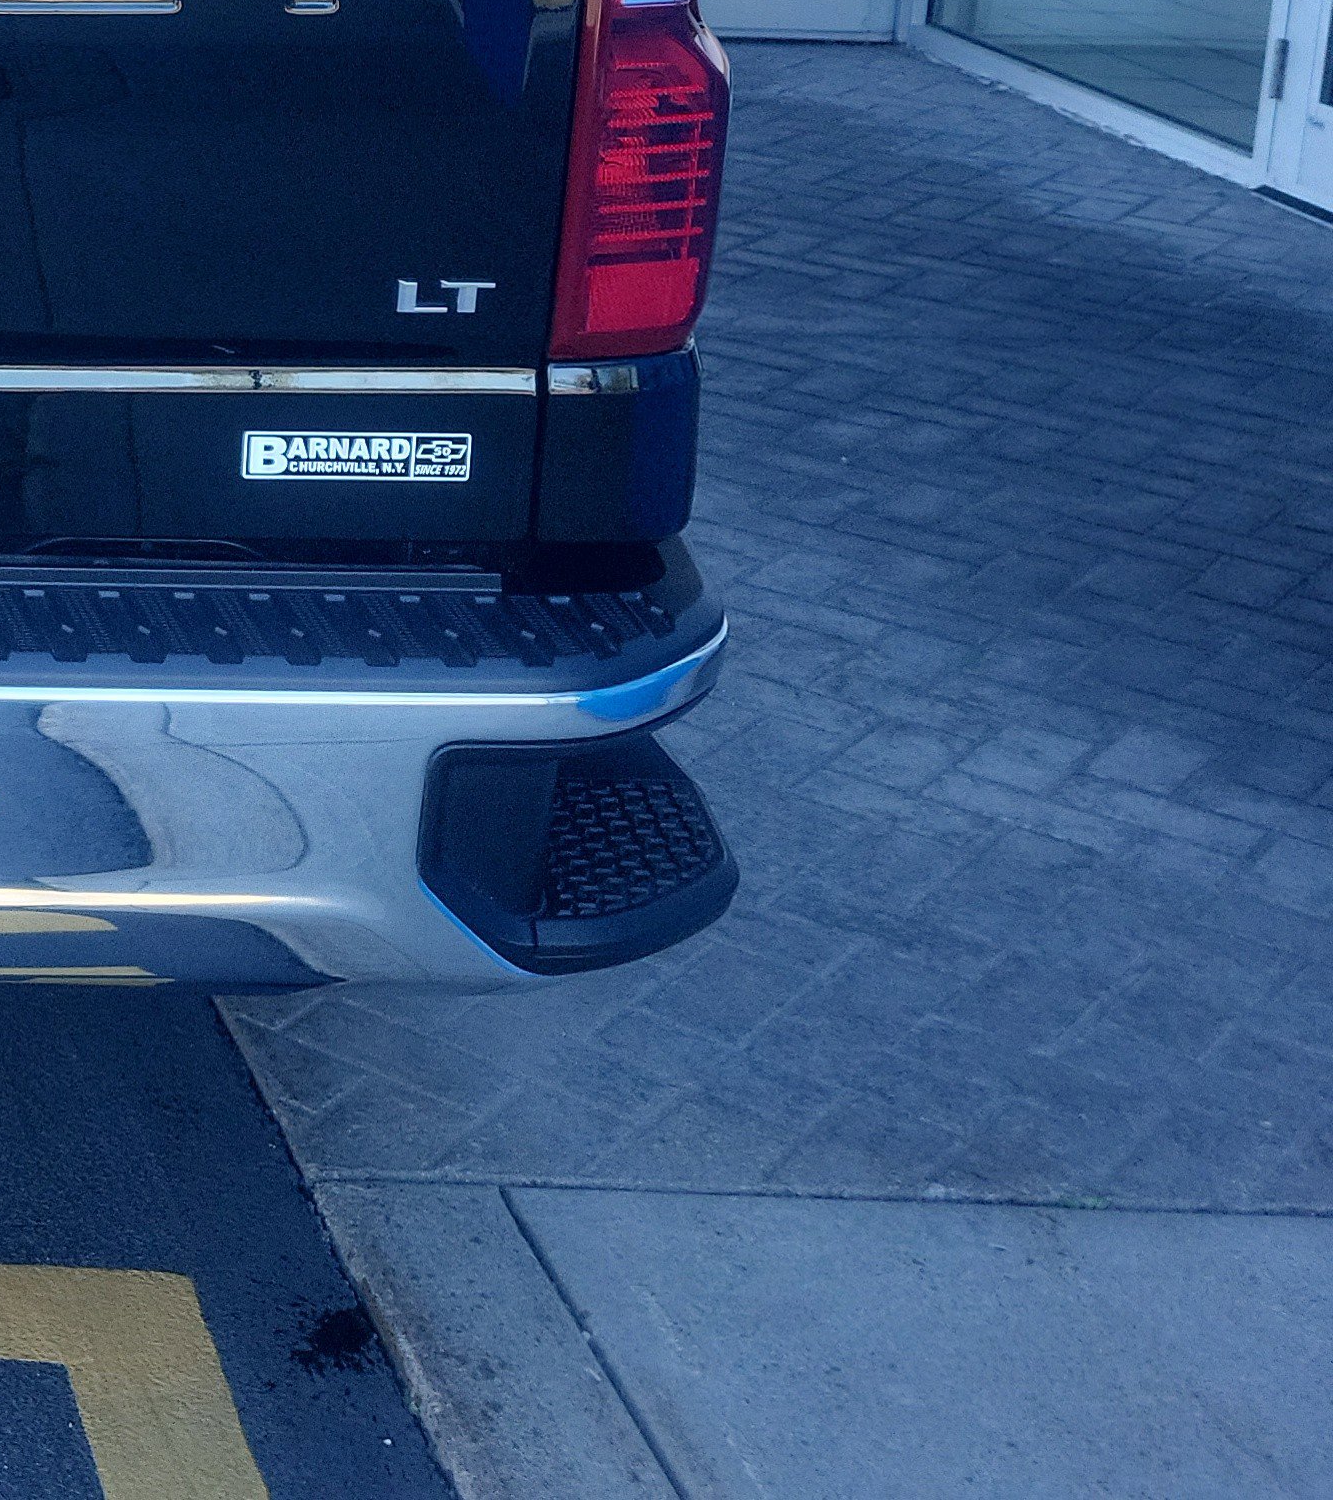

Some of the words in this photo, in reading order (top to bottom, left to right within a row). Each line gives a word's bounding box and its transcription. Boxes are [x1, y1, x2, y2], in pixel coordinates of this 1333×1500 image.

[396, 279, 496, 313] LT
[248, 436, 411, 474] BARNARD
[382, 462, 406, 474] N.Y.
[415, 464, 441, 475] SINCE
[444, 465, 467, 475] 1972
